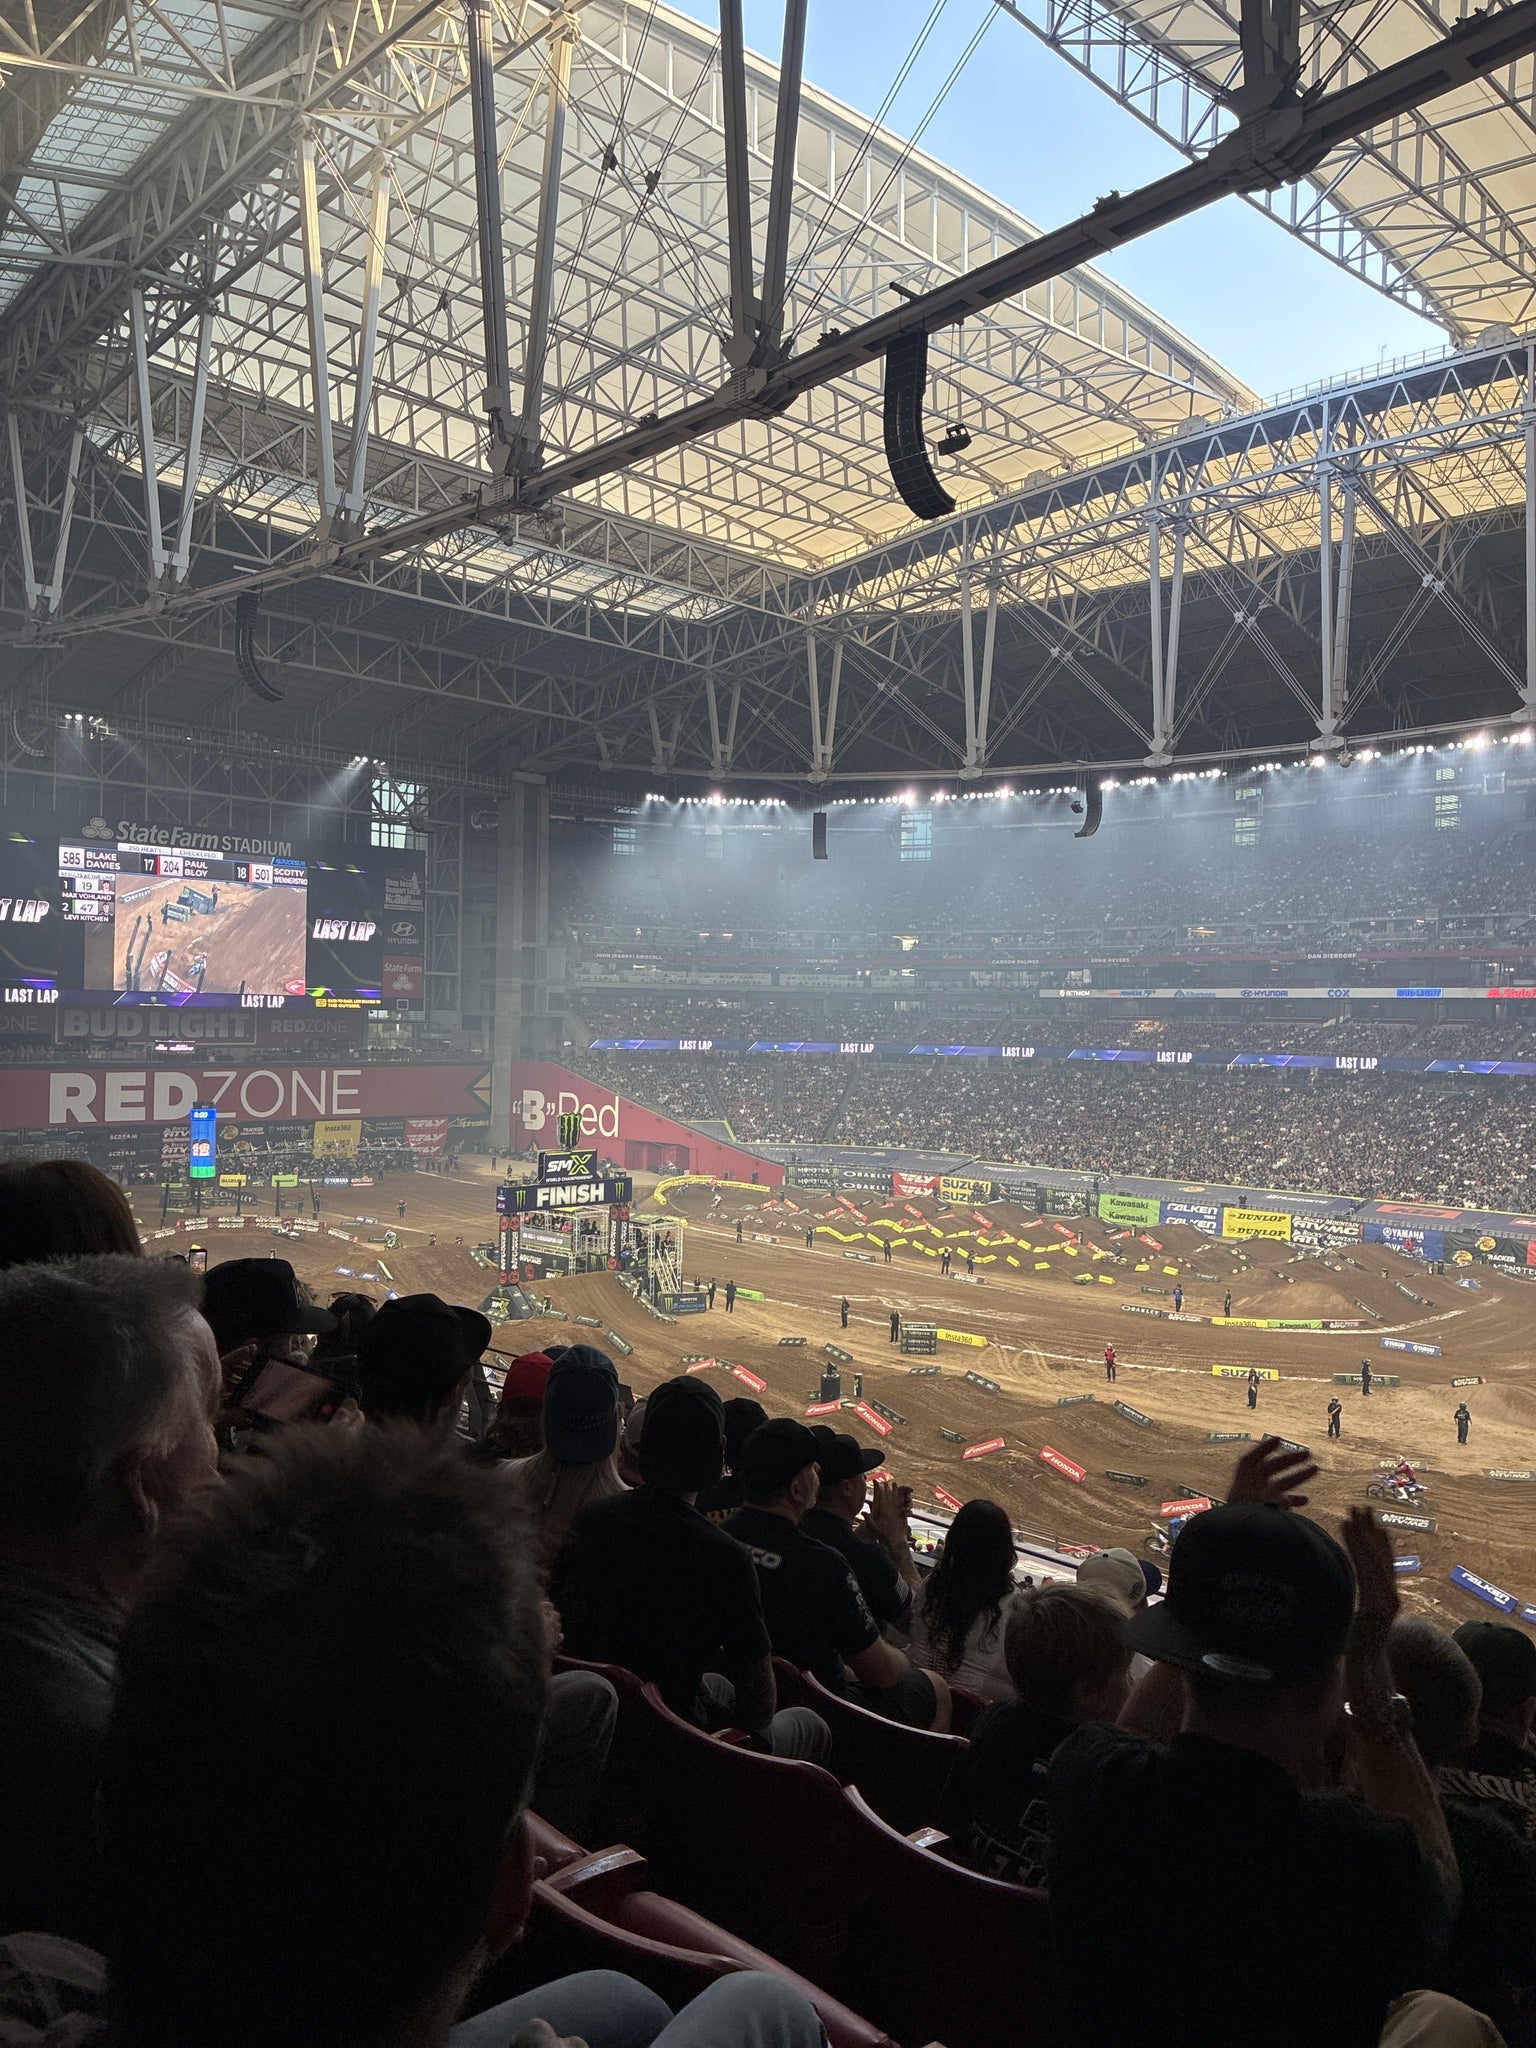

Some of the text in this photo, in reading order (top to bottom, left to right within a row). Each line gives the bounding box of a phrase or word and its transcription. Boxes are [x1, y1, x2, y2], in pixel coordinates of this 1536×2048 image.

[221, 835, 292, 857] STADIUM
[62, 851, 81, 865] 585
[86, 851, 117, 861] BLAKE
[86, 861, 121, 871] DAVIES
[143, 858, 155, 871] 17
[163, 860, 180, 873] 204
[184, 860, 209, 869] PAUL
[184, 868, 209, 878] BLOY
[236, 866, 247, 879] 18
[255, 868, 270, 880] 501
[273, 867, 305, 877] SCOTTY
[63, 880, 68, 889] 1
[81, 881, 93, 891] 19
[62, 891, 112, 901] MAX VOHLAND
[12, 898, 50, 923] LAP
[61, 902, 69, 911] 2
[80, 903, 94, 912] 47
[80, 914, 109, 922] KITCHEN
[313, 918, 377, 942] LAST LAP
[388, 937, 419, 945] HYUNDAI
[4, 988, 59, 1004] LAST LAP
[1327, 989, 1350, 998] COX
[241, 994, 285, 1009] LAST LAP
[64, 1009, 249, 1039] BUD LIGHT
[271, 1019, 347, 1034] REDZONE
[679, 1039, 713, 1051] LAST LAP
[840, 1042, 875, 1054] LAST LAP
[1001, 1046, 1035, 1058] LAST LAP
[1156, 1051, 1193, 1063] LAST LAP
[1335, 1056, 1378, 1070] LAST LAP
[49, 1069, 362, 1124] REDZONE
[546, 1153, 592, 1176] SMX
[857, 1172, 892, 1180] OAKLEY
[898, 1172, 936, 1184] FLY
[536, 1182, 605, 1208] FINISH
[1110, 1198, 1149, 1210] Kawasaki
[1166, 1202, 1218, 1215] FALKEN
[1108, 1211, 1148, 1223] Kawasaki
[1165, 1216, 1217, 1230] FALKEN
[1237, 1212, 1287, 1223] DUNLOP
[1325, 1218, 1360, 1227] MOUNTAIN
[1236, 1226, 1286, 1238] DUNLOP
[1392, 1228, 1425, 1241] YAMAHA
[1131, 1305, 1160, 1315] OAKLEY
[945, 1332, 973, 1345] Insta360
[692, 1361, 711, 1371] HONDA
[1220, 1368, 1272, 1380] SUZKI
[739, 1370, 762, 1391] HONDA
[813, 1406, 836, 1414] HONDA
[1124, 1406, 1144, 1421] MONSTER
[862, 1409, 887, 1433] HONDA
[1050, 1456, 1082, 1480] HONDA
[1171, 1503, 1205, 1513] HONDA
[1461, 1571, 1510, 1602] FALKEN
